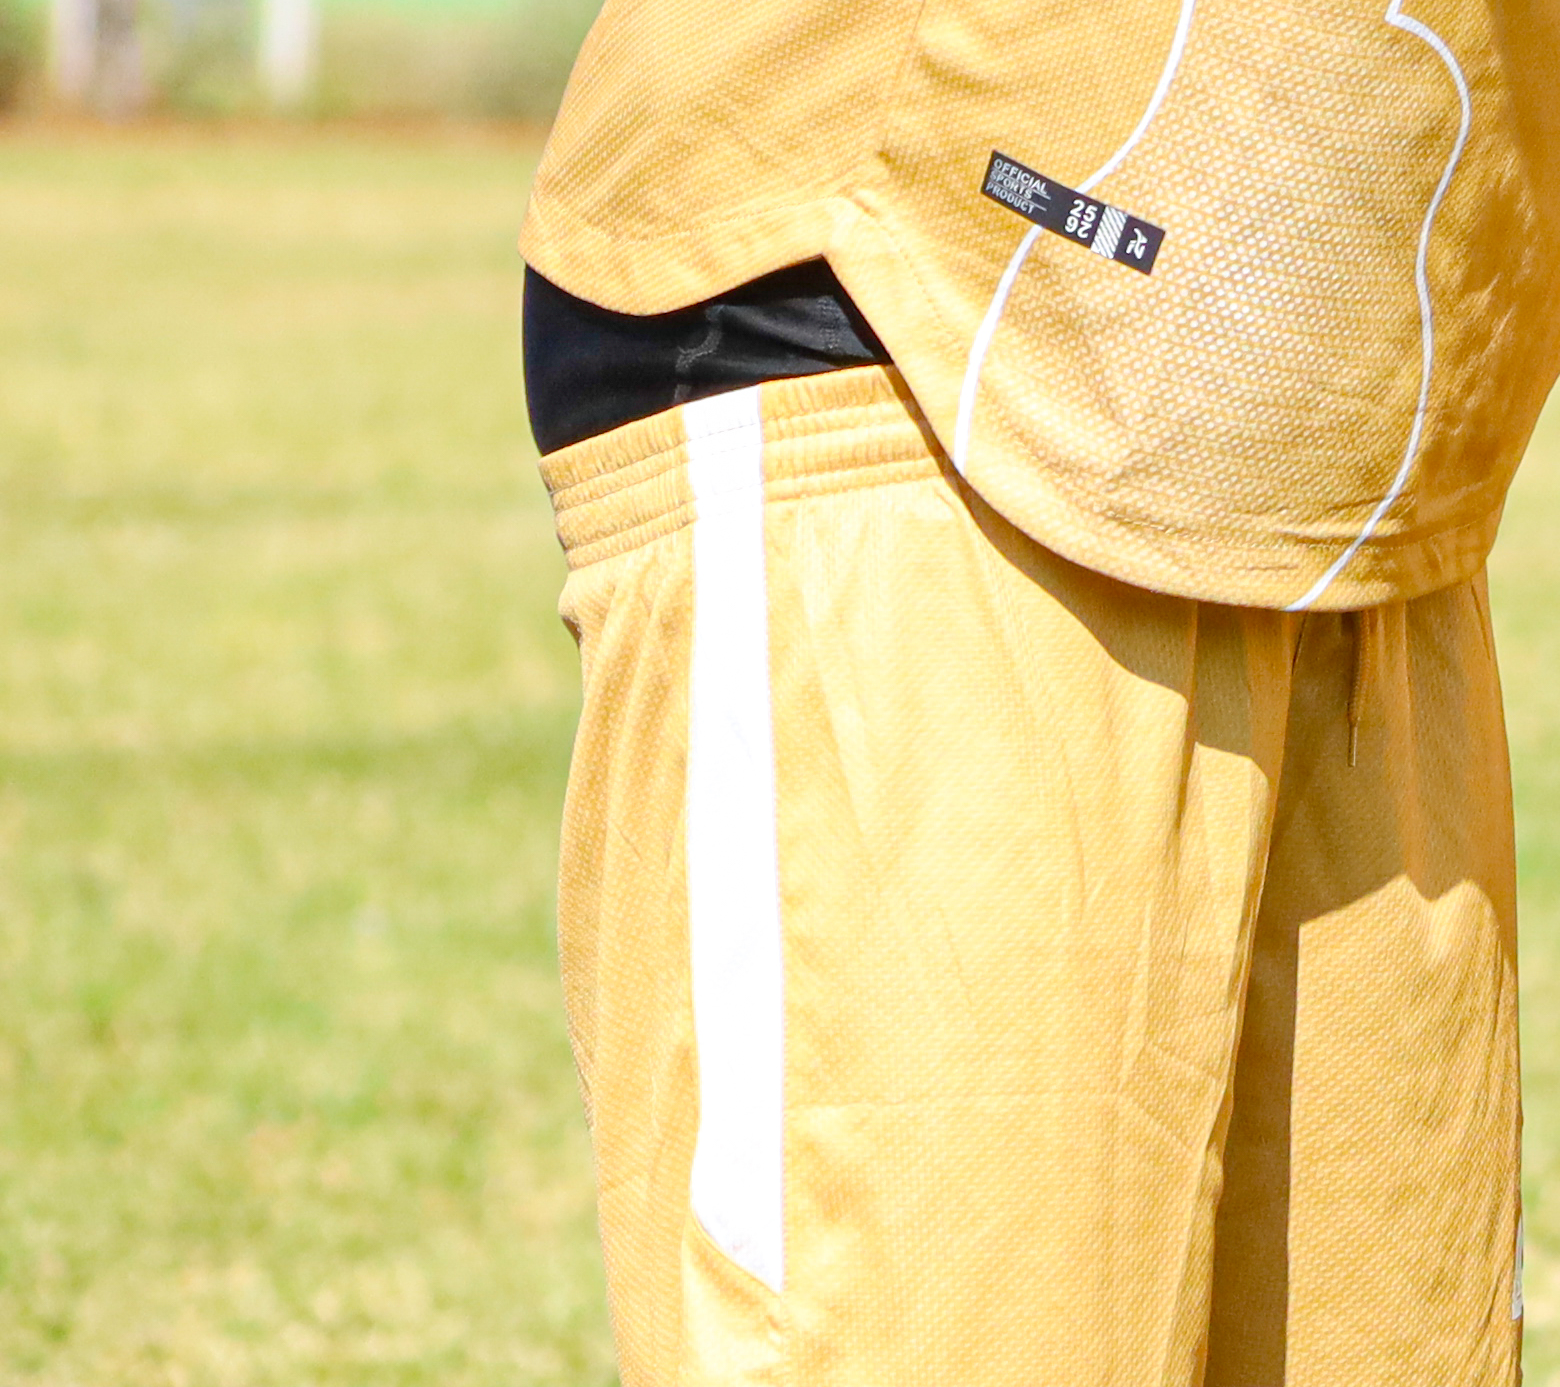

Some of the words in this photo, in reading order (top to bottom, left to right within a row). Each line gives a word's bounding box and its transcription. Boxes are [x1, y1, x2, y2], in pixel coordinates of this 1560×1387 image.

[989, 170, 1033, 200] SPORTS
[993, 157, 1049, 195] OFFICIAL
[985, 181, 1036, 215] PRODUCT
[1069, 199, 1099, 223] 25
